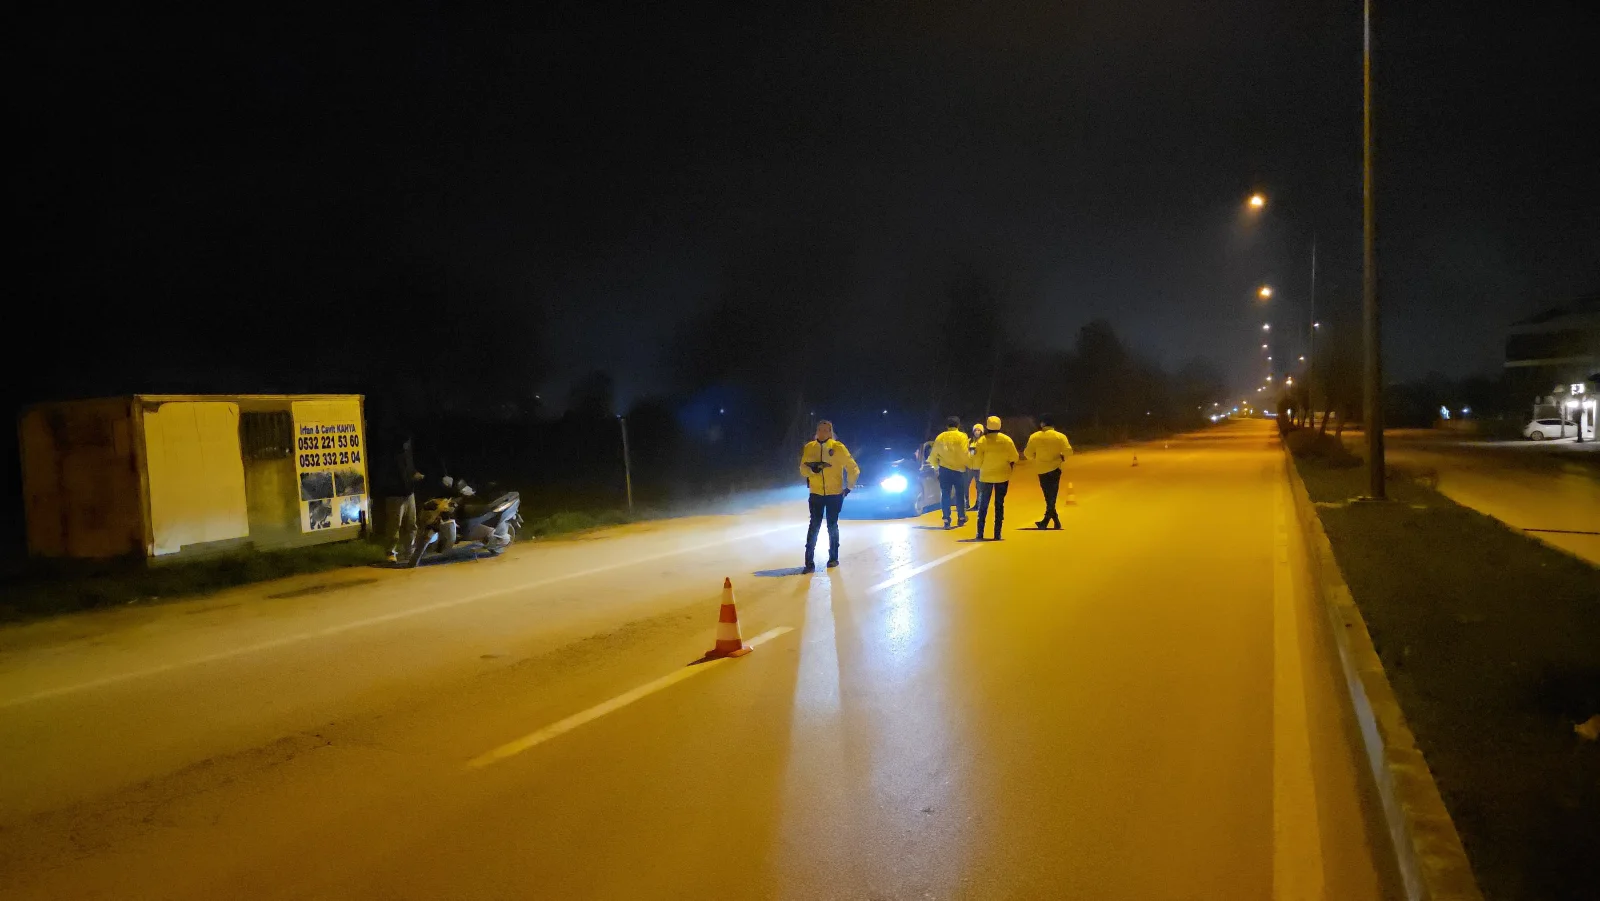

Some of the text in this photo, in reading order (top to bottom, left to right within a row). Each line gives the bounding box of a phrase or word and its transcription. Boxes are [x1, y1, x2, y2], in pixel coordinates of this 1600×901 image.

[315, 425, 319, 434] &
[337, 424, 356, 432] KAHYA
[298, 435, 359, 450] 0532 221 53 60
[300, 451, 360, 468] 0532 332 25 04
